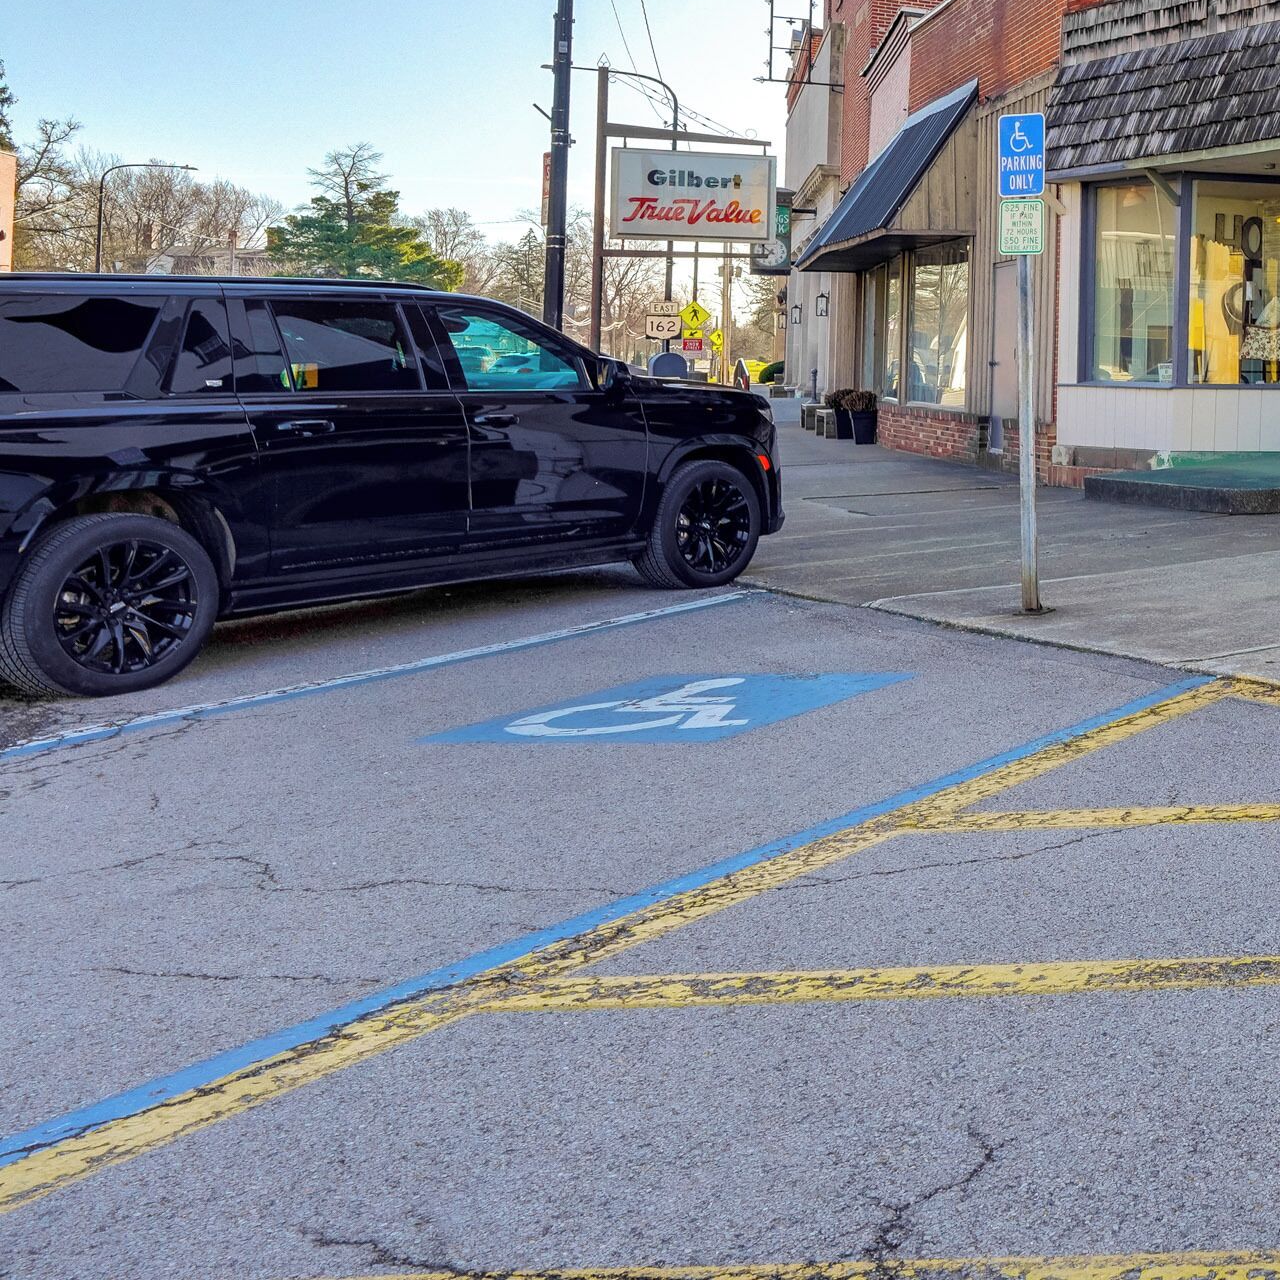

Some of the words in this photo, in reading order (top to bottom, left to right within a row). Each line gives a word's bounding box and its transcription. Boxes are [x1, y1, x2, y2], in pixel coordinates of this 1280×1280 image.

[1001, 155, 1042, 171] PARKING
[647, 169, 742, 189] Gilbert
[1010, 174, 1033, 190] ONLY
[622, 197, 685, 222] True
[672, 198, 762, 225] Value
[653, 304, 674, 312] EAST
[650, 320, 676, 332] 162
